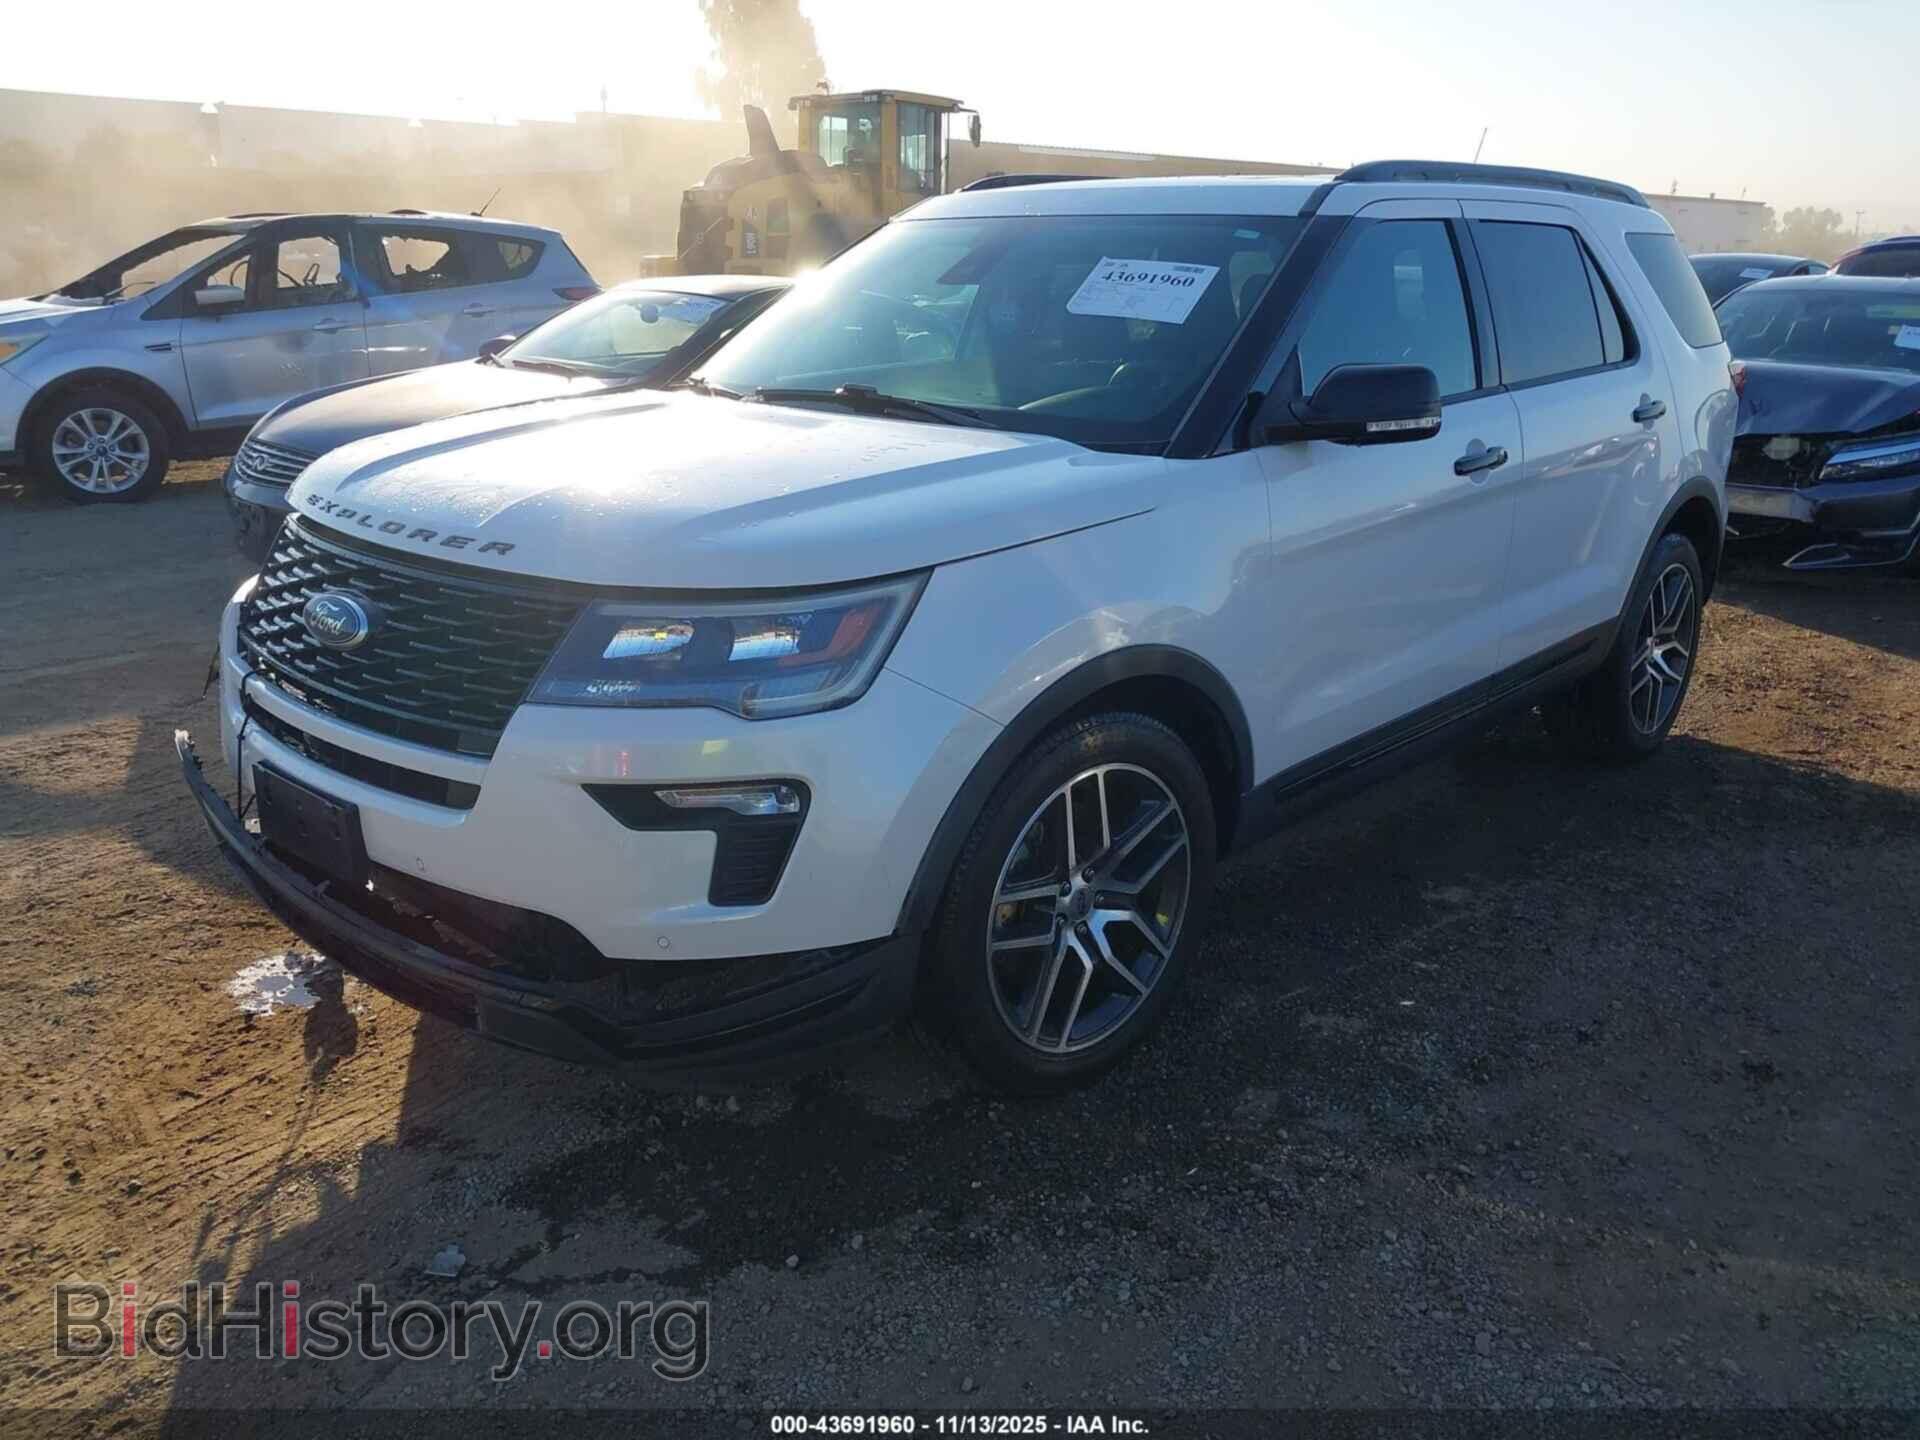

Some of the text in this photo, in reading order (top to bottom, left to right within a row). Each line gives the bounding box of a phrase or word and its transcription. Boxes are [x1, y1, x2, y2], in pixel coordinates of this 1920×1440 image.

[1101, 271, 1196, 288] 43691960
[306, 493, 516, 556] EXPLORER
[309, 600, 347, 636] Ford
